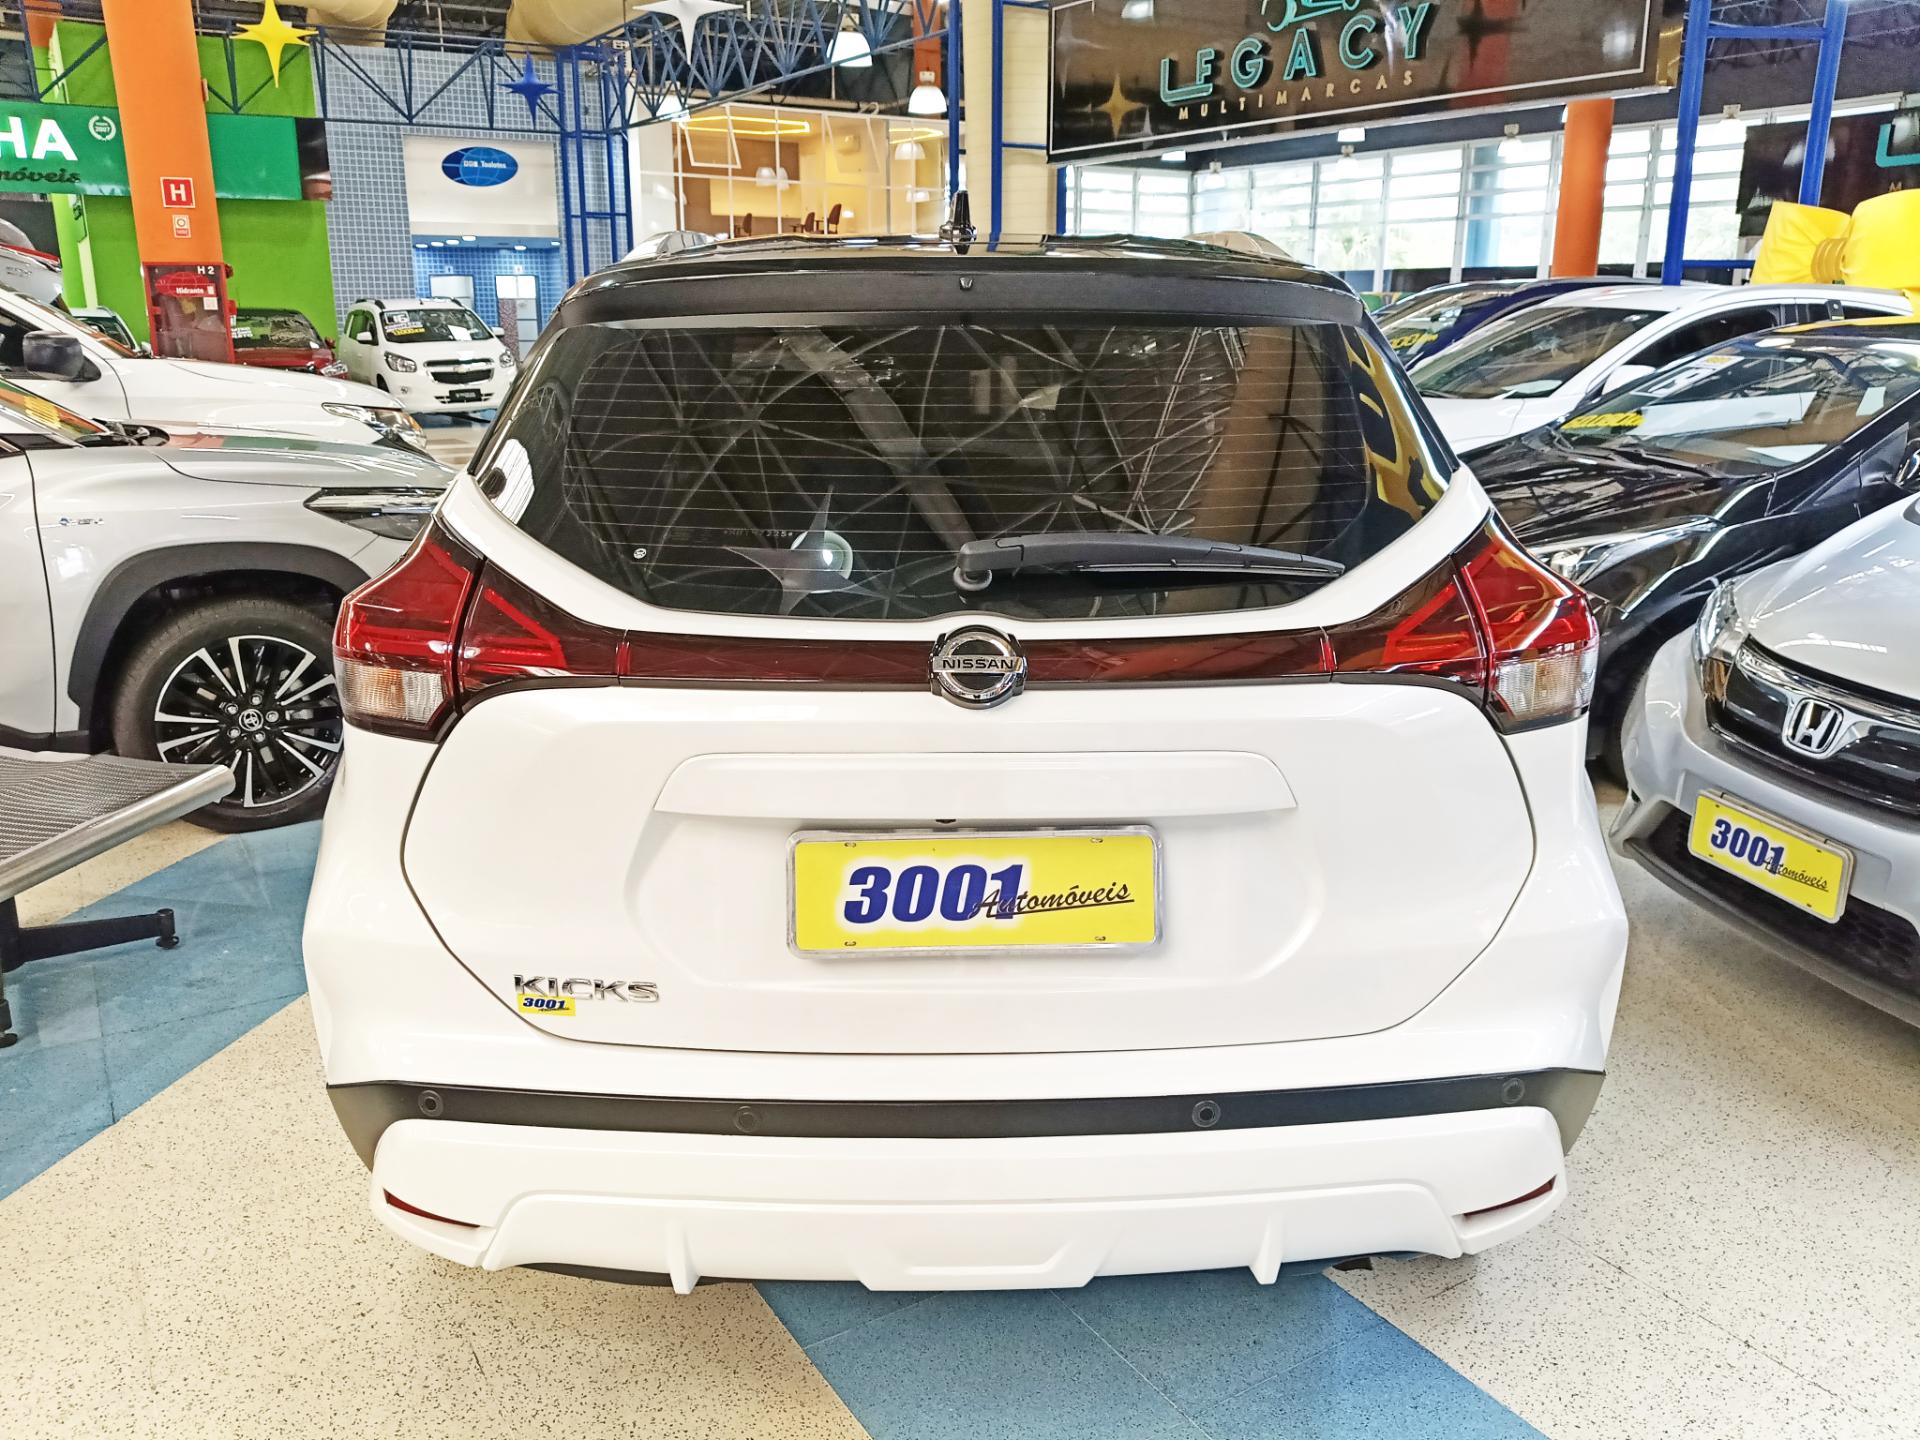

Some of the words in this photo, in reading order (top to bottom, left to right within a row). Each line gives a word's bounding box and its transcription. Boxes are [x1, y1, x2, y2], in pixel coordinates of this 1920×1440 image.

[1160, 3, 1430, 104] LEGACY
[1178, 70, 1413, 121] MULTIMARCAS
[170, 183, 187, 202] H
[197, 266, 206, 275] H
[207, 266, 215, 275] 2
[942, 658, 1014, 669] NISSAN
[1710, 818, 1785, 875] 3001
[844, 864, 1023, 923] 3001
[970, 880, 1131, 919] Automóveis
[513, 974, 660, 1003] KICKS
[522, 997, 566, 1009] 3001
